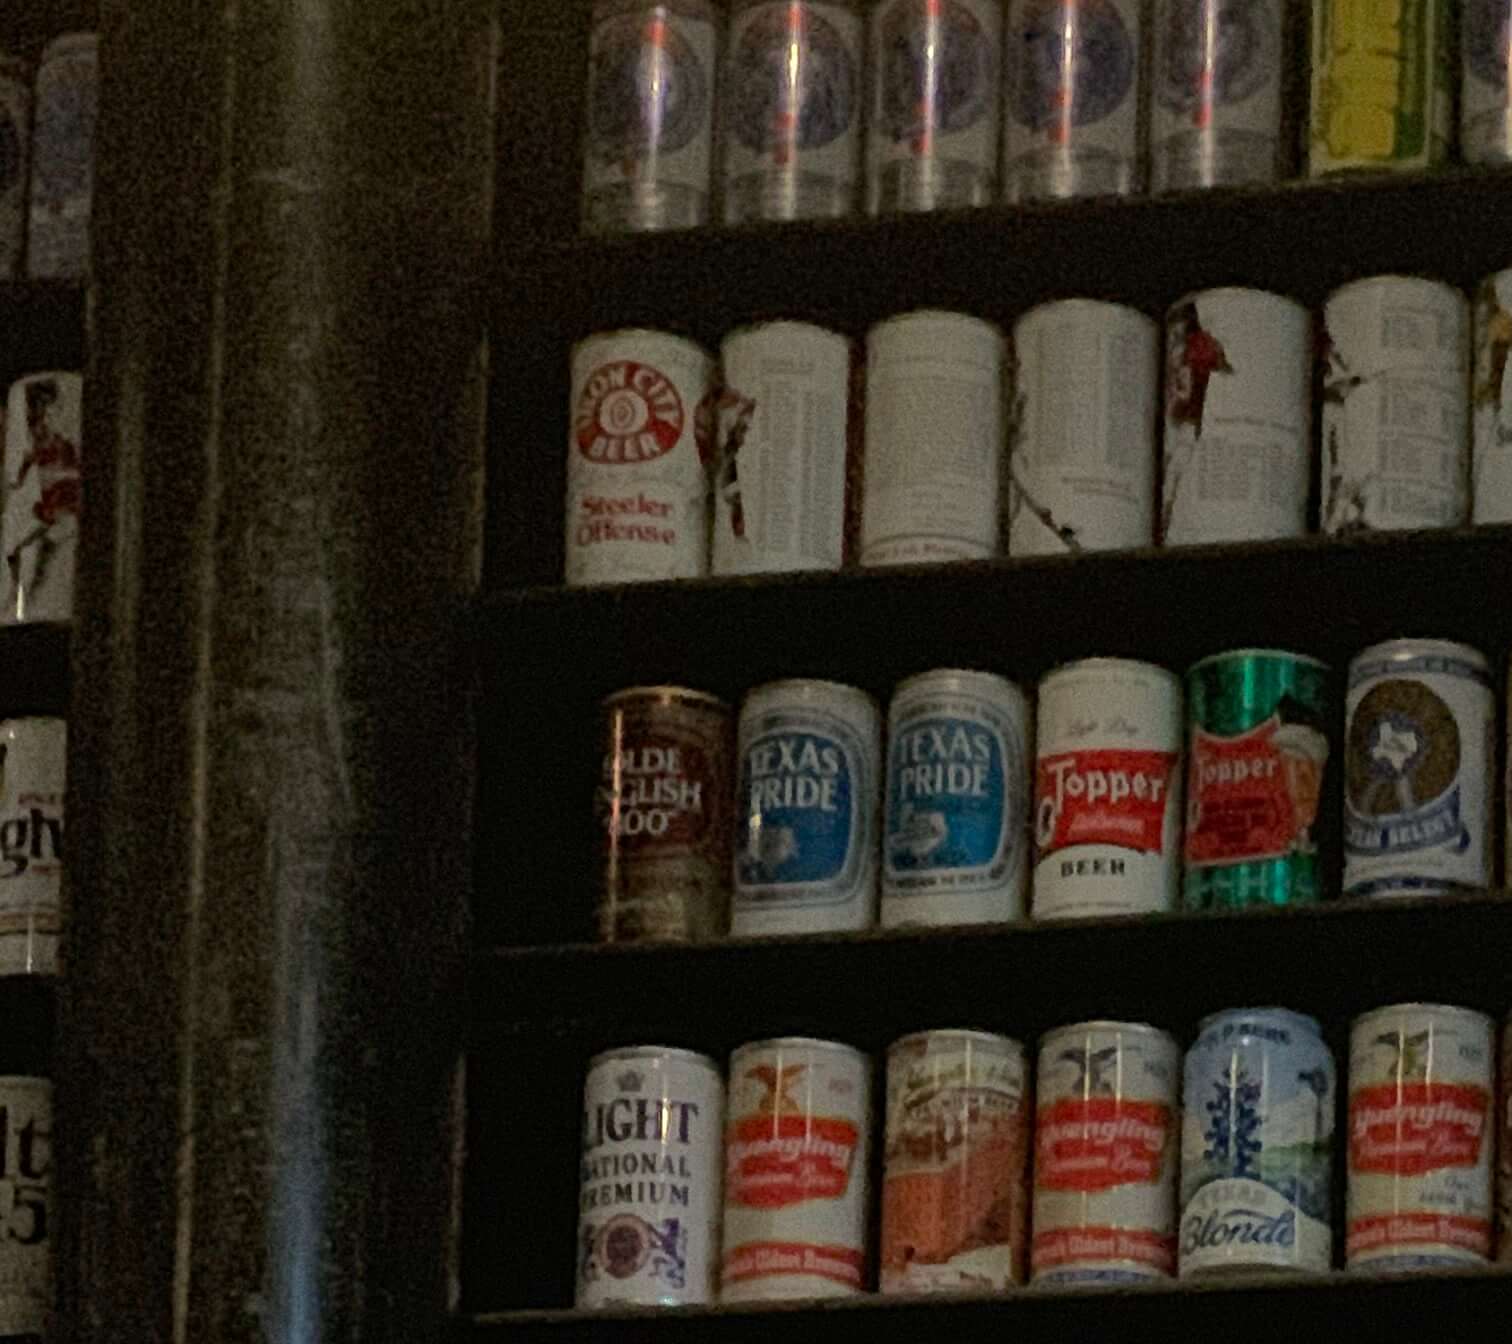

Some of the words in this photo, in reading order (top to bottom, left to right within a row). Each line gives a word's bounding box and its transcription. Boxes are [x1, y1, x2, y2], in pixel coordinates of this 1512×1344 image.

[631, 368, 683, 424] CITY
[590, 431, 660, 461] BEER
[576, 518, 677, 547] Offense
[750, 741, 841, 777] TEXAS
[899, 726, 989, 763] TEXAS
[750, 776, 849, 812] PRIDE
[899, 764, 988, 800] PRIDE
[1047, 757, 1165, 816] Topper
[1061, 859, 1126, 877] BEER
[1183, 1209, 1296, 1250] Blonde
